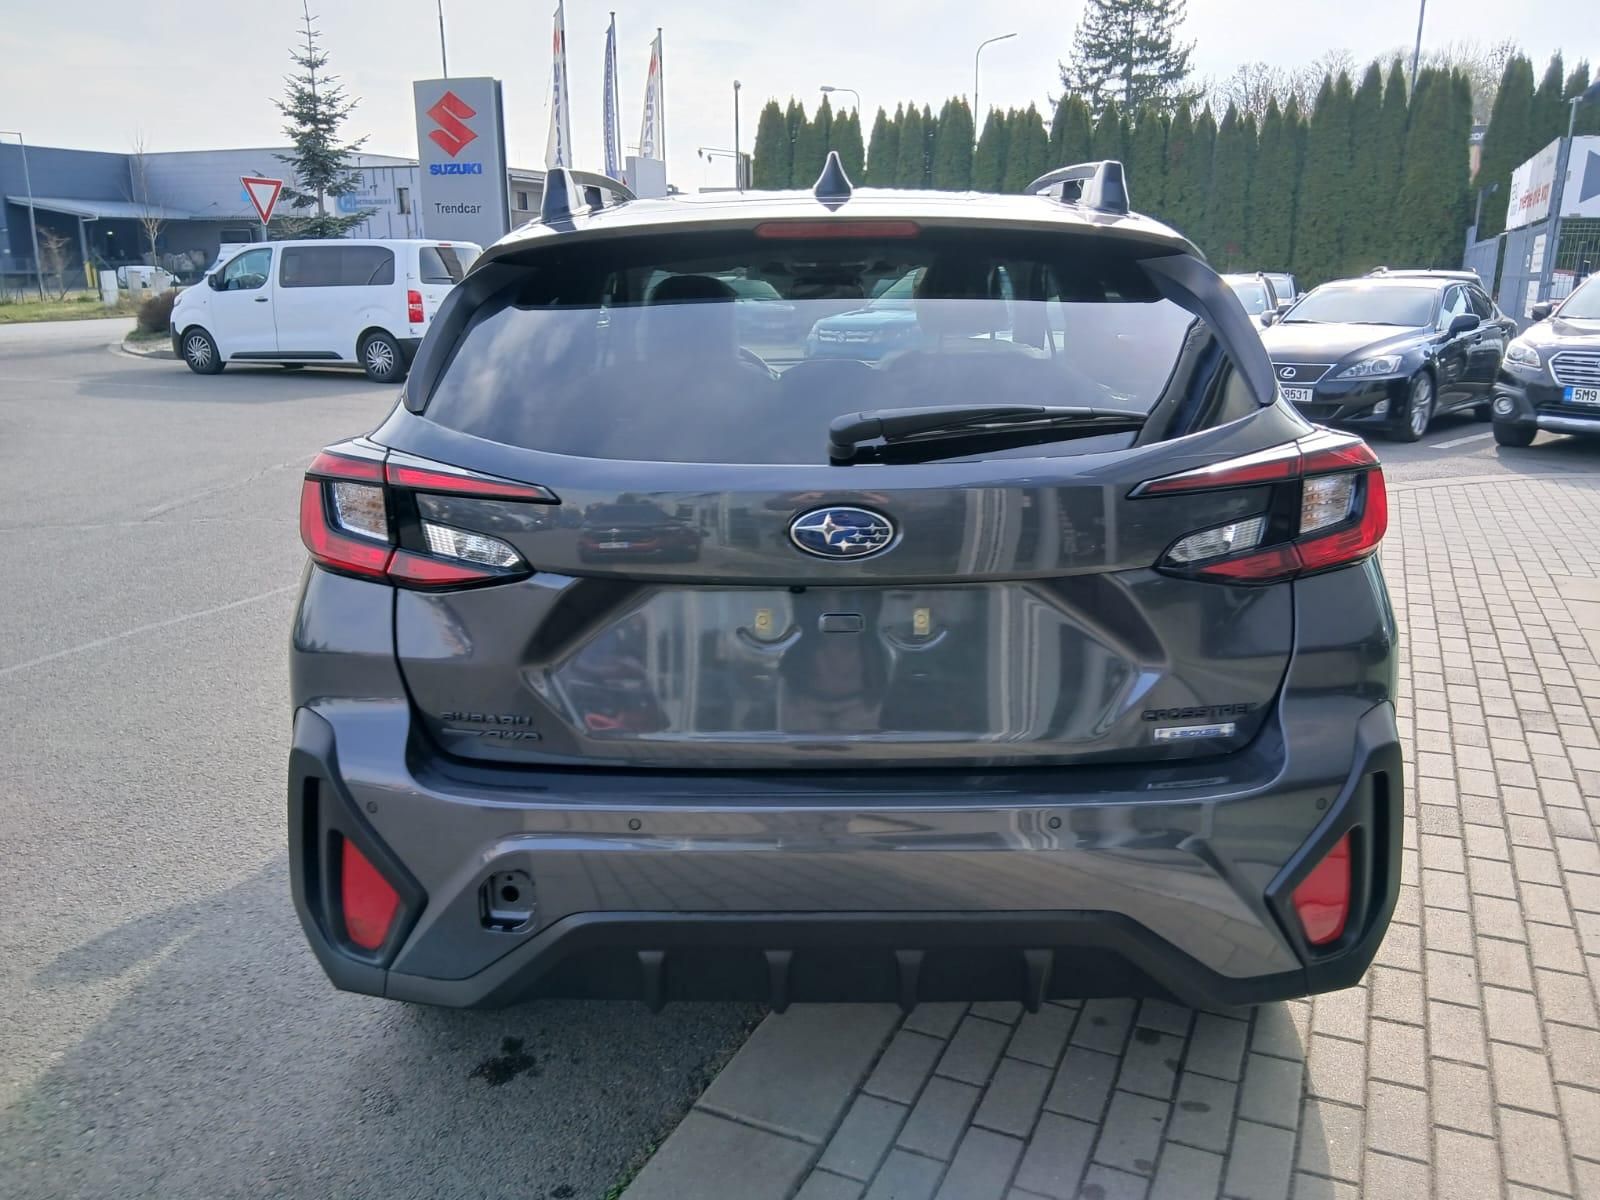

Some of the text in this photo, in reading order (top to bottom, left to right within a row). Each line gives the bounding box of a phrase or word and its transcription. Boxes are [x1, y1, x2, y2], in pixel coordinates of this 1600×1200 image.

[430, 162, 482, 175] SUZUKI
[434, 203, 482, 214] Trendcar
[1574, 389, 1598, 401] 5M9
[441, 711, 532, 726] SUBARU
[484, 729, 543, 741] AWD
